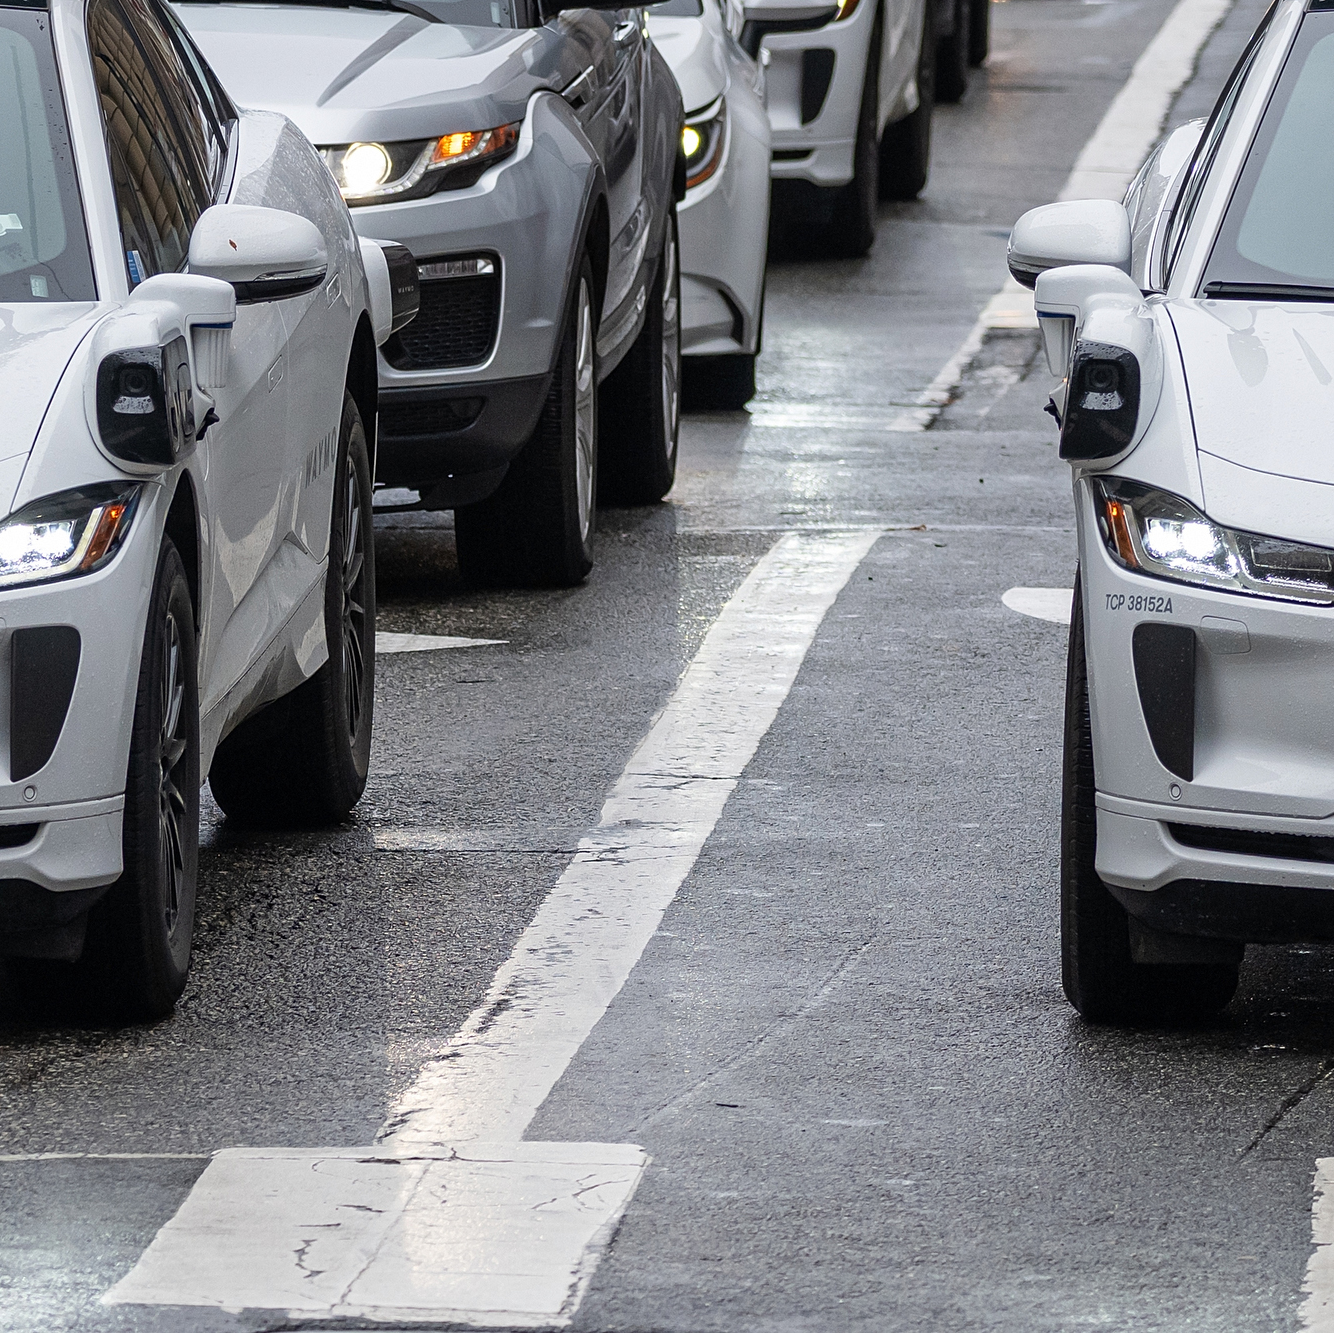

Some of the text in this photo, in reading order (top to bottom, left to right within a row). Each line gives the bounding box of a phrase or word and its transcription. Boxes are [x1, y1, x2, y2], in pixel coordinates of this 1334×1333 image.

[304, 426, 337, 489] WAYMO
[1105, 593, 1173, 614] TCP 38152A
